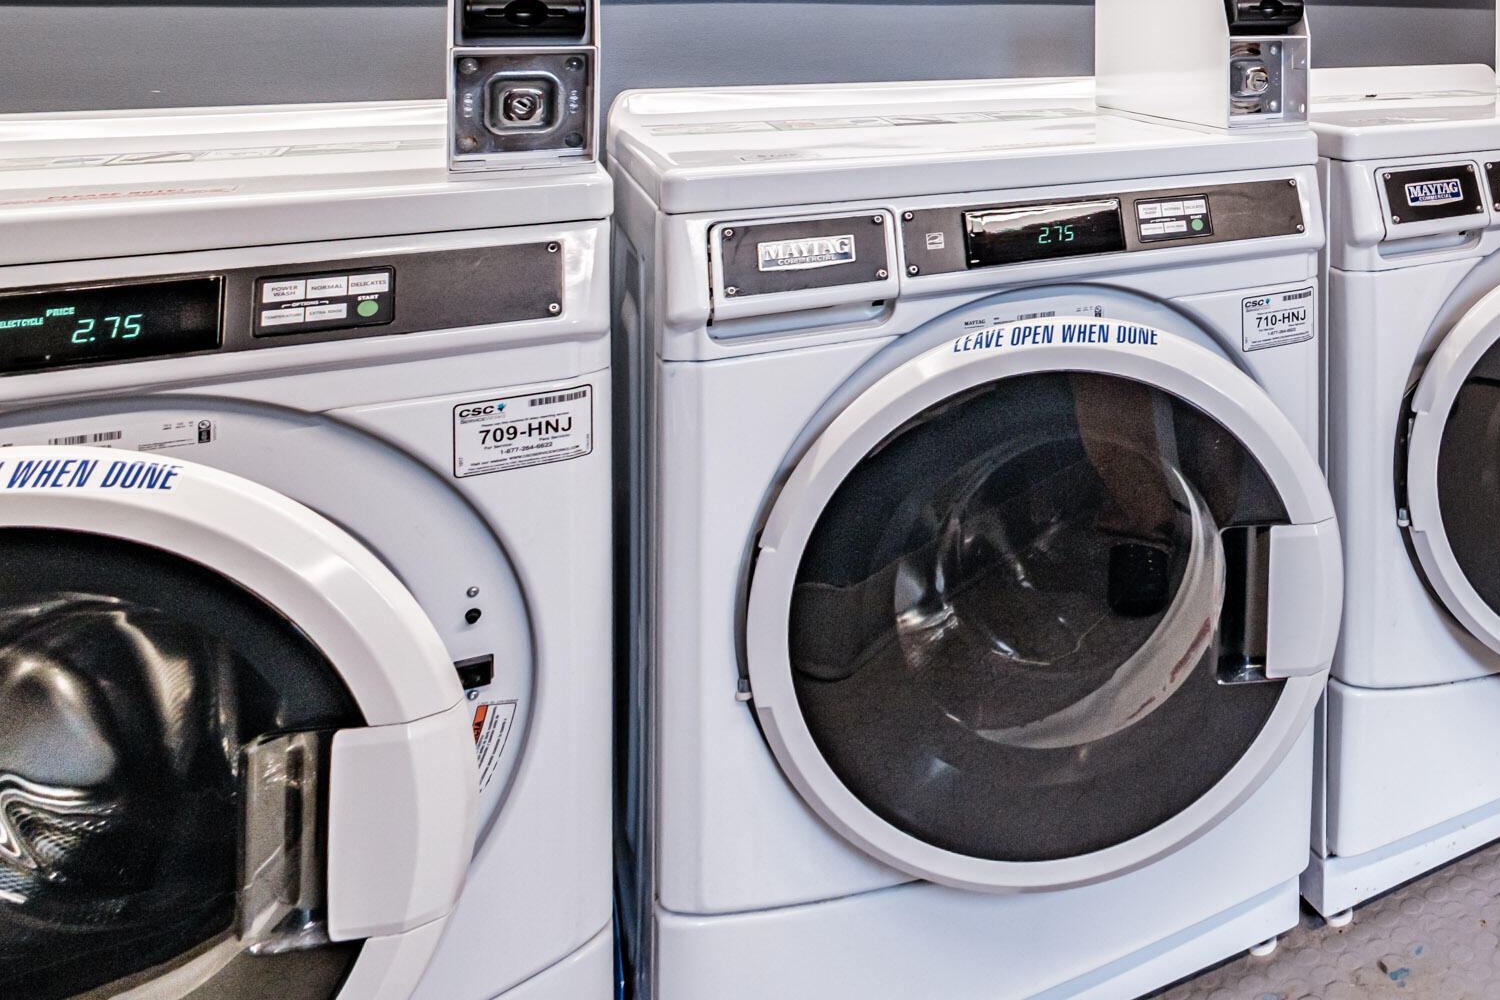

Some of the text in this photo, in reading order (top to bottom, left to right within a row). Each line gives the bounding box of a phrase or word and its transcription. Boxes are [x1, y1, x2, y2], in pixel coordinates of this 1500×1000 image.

[1408, 181, 1458, 198] MAYTAG
[1038, 224, 1075, 244] 2.75
[764, 238, 850, 261] MAYTAG
[777, 254, 835, 266] COMMERCIAL
[350, 279, 387, 288] DELICATES
[46, 306, 75, 317] PRICE
[1245, 299, 1265, 308] CSC
[0, 317, 44, 329] ELECT CYCLE
[964, 318, 986, 326] MAYTAG
[1256, 309, 1306, 328] 710-HNJ
[71, 314, 143, 343] 2.75
[953, 324, 1158, 353] LEAVE OPEN WHEN DONE
[459, 405, 495, 418] CSC
[479, 416, 572, 445] 709-HNJ
[6, 459, 99, 489] WHEN
[100, 460, 184, 490] DONE
